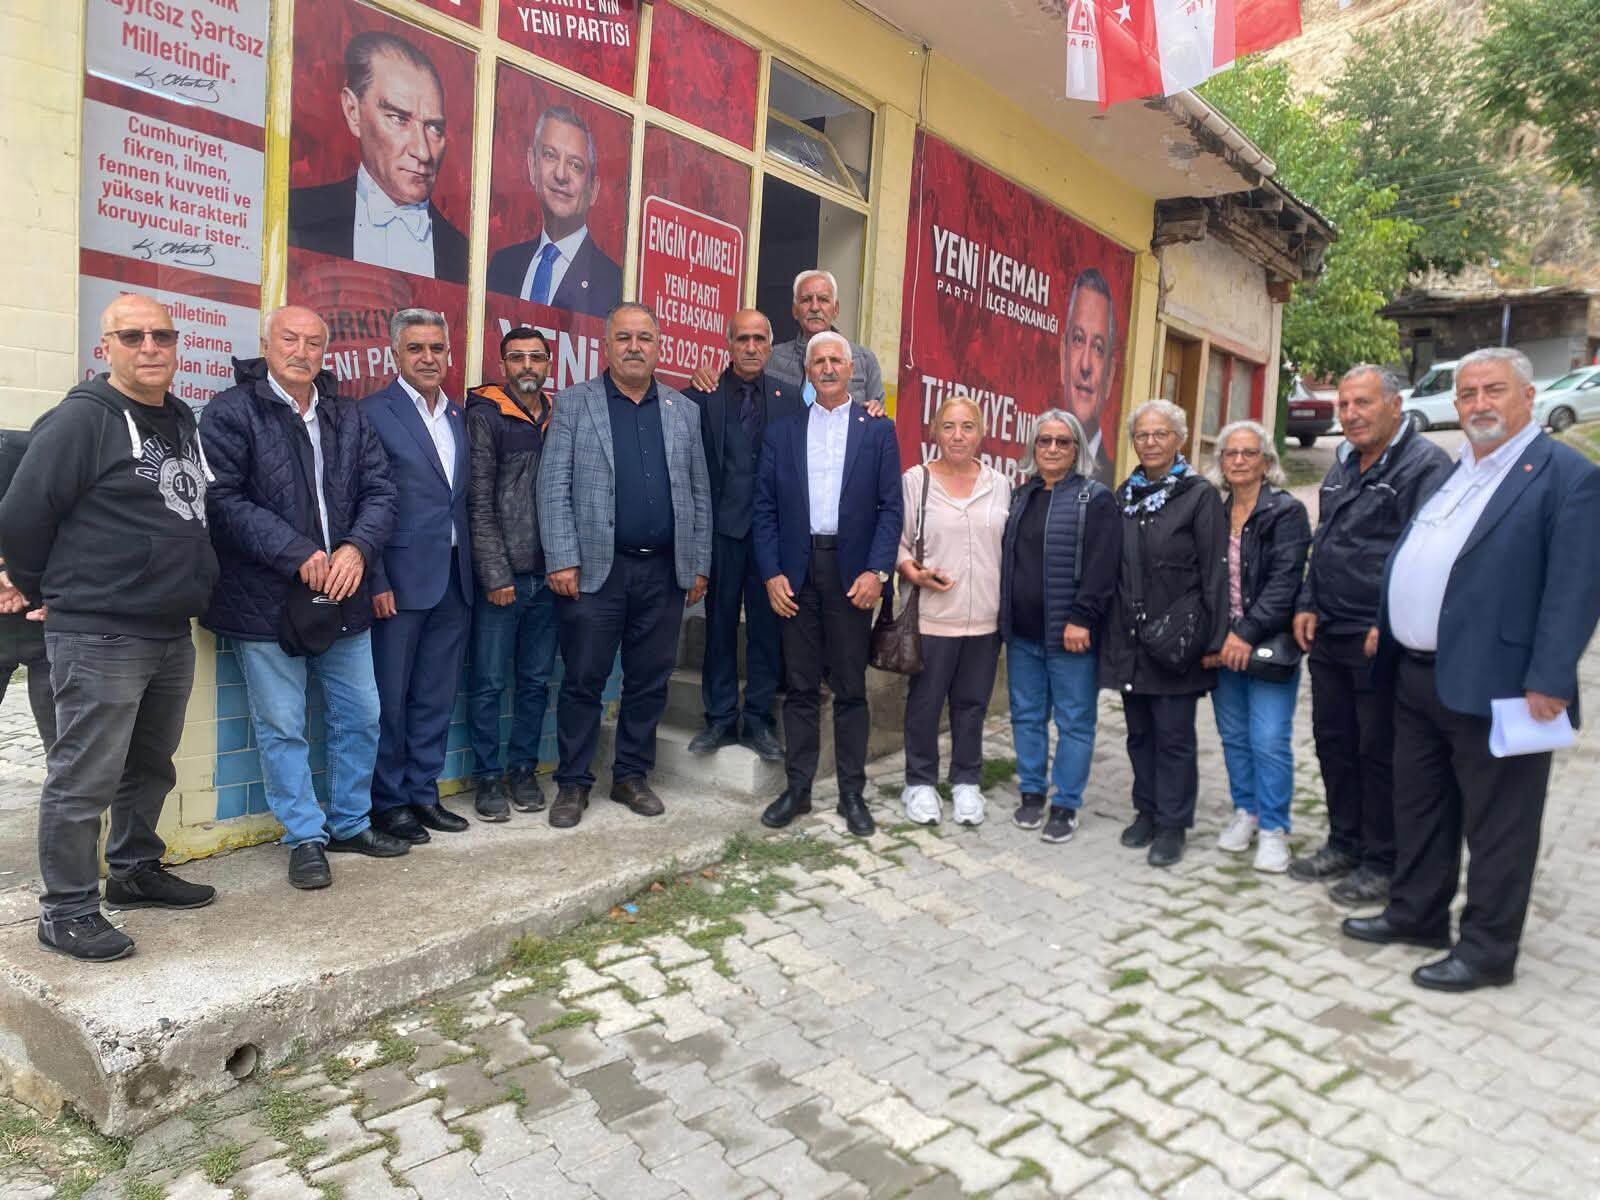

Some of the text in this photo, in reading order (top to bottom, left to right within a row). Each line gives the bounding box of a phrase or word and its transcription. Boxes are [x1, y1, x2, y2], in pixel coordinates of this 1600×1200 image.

[122, 21, 236, 84] Milletindir.
[191, 9, 264, 58] Şartsız
[123, 137, 230, 184] fikren, ilmen,
[128, 116, 227, 162] Cumhuriyet,
[98, 153, 251, 209] fennen kuvvetli ve
[102, 179, 247, 228] yüksek karakterli
[97, 198, 249, 249] koruyucular ister..
[648, 215, 737, 277] ENGİN ÇAMBELİ
[664, 272, 720, 309] YENİ PARTİ
[988, 249, 1050, 307] KEMAH
[656, 291, 724, 335] İLÇE BAŞKANI
[986, 287, 1059, 334] İLÇE BAŞKANLIĞI
[183, 332, 233, 354] şiarına
[659, 334, 674, 364] 35
[677, 338, 698, 370] 029
[176, 356, 234, 378] lan idar
